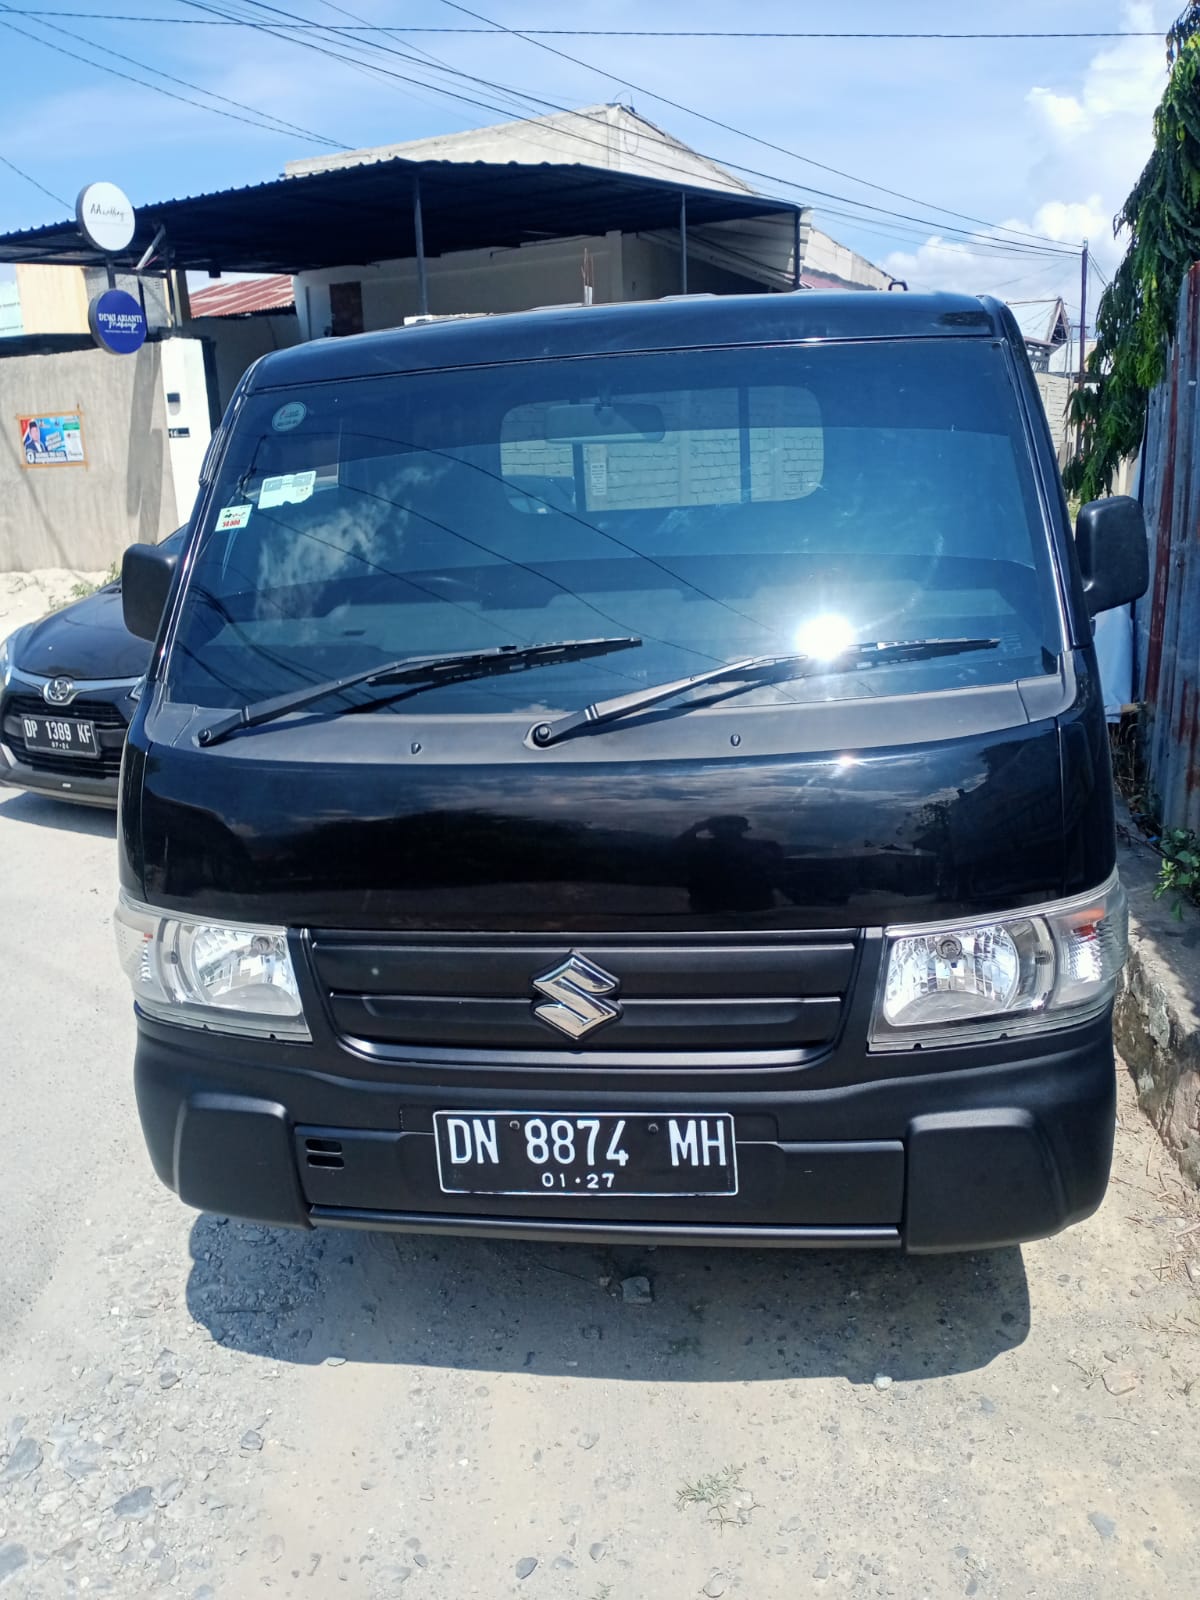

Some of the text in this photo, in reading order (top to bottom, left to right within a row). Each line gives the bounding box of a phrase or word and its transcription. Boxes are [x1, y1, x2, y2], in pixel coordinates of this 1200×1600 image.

[23, 719, 92, 743] DP 1389 KF
[447, 1118, 728, 1167] DN 8874 MH
